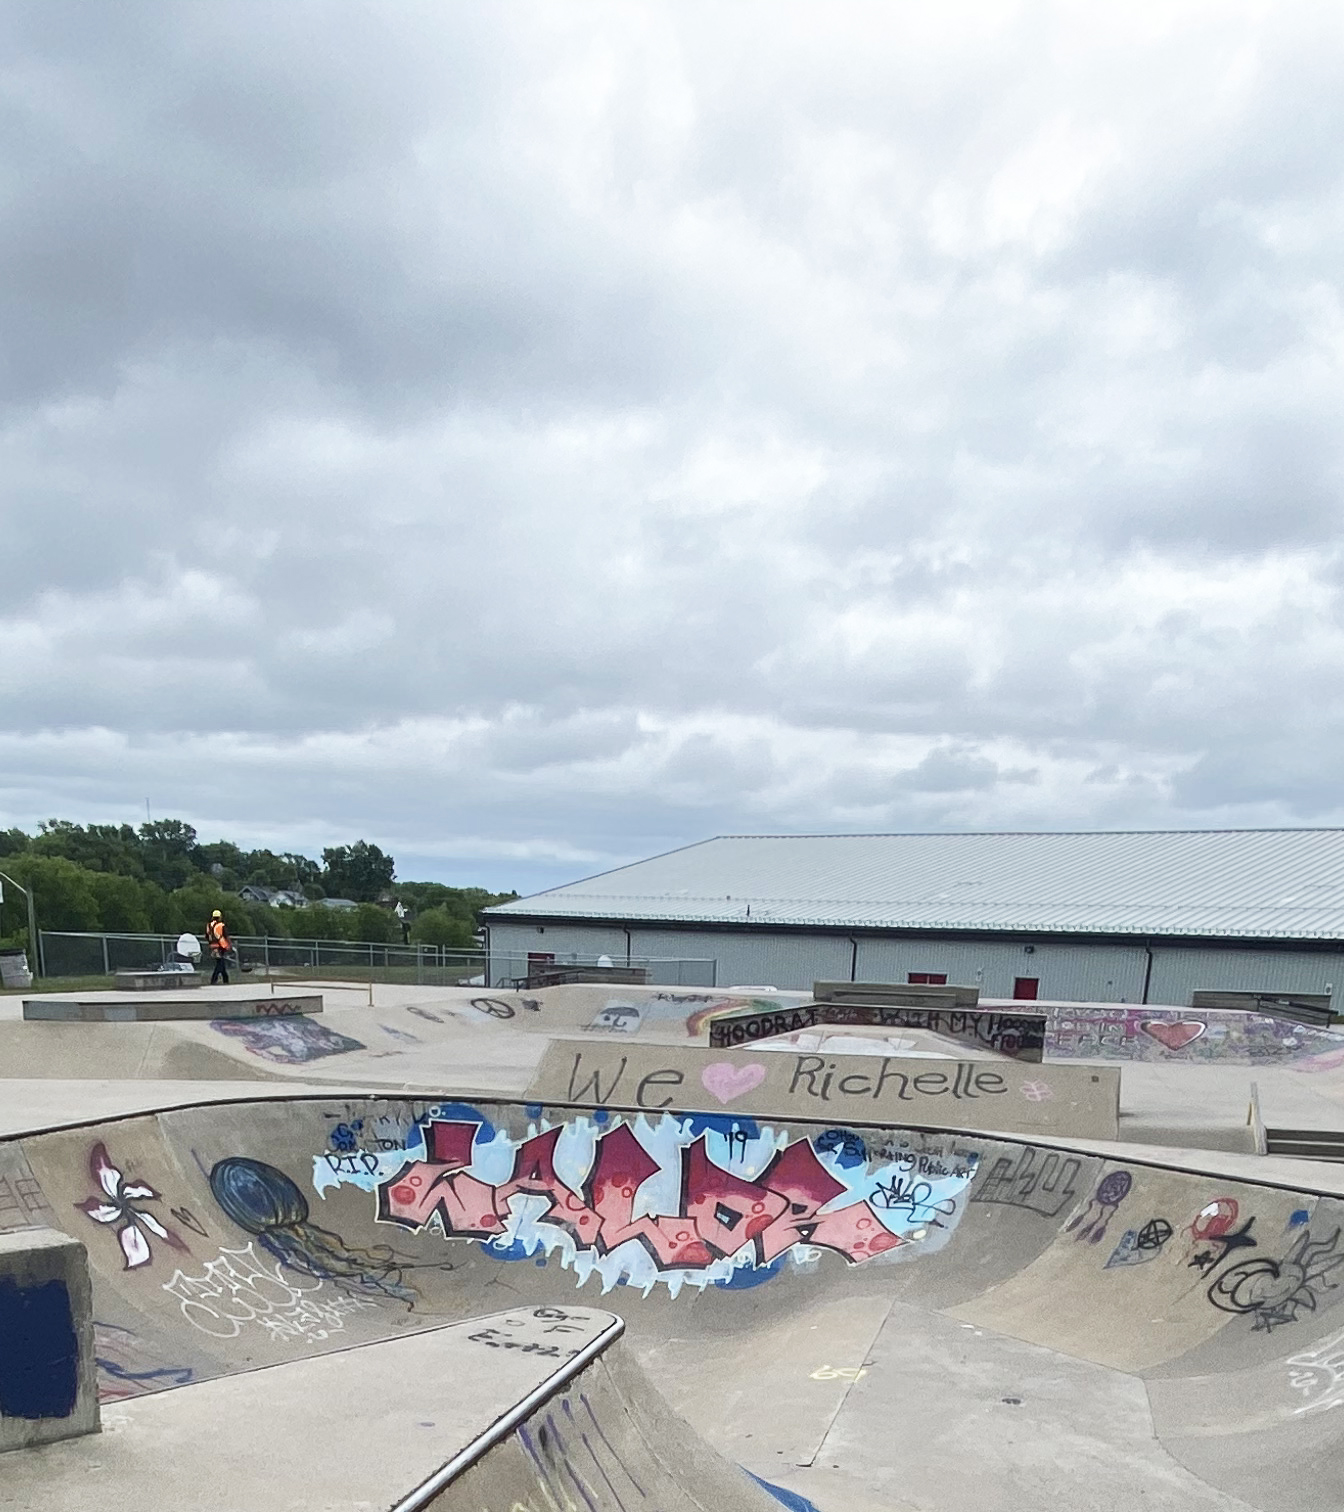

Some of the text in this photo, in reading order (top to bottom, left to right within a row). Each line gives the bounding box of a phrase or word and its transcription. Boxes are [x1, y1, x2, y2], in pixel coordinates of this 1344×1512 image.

[566, 1052, 1010, 1110] We Richelle
[324, 1153, 384, 1177] R.I.P.
